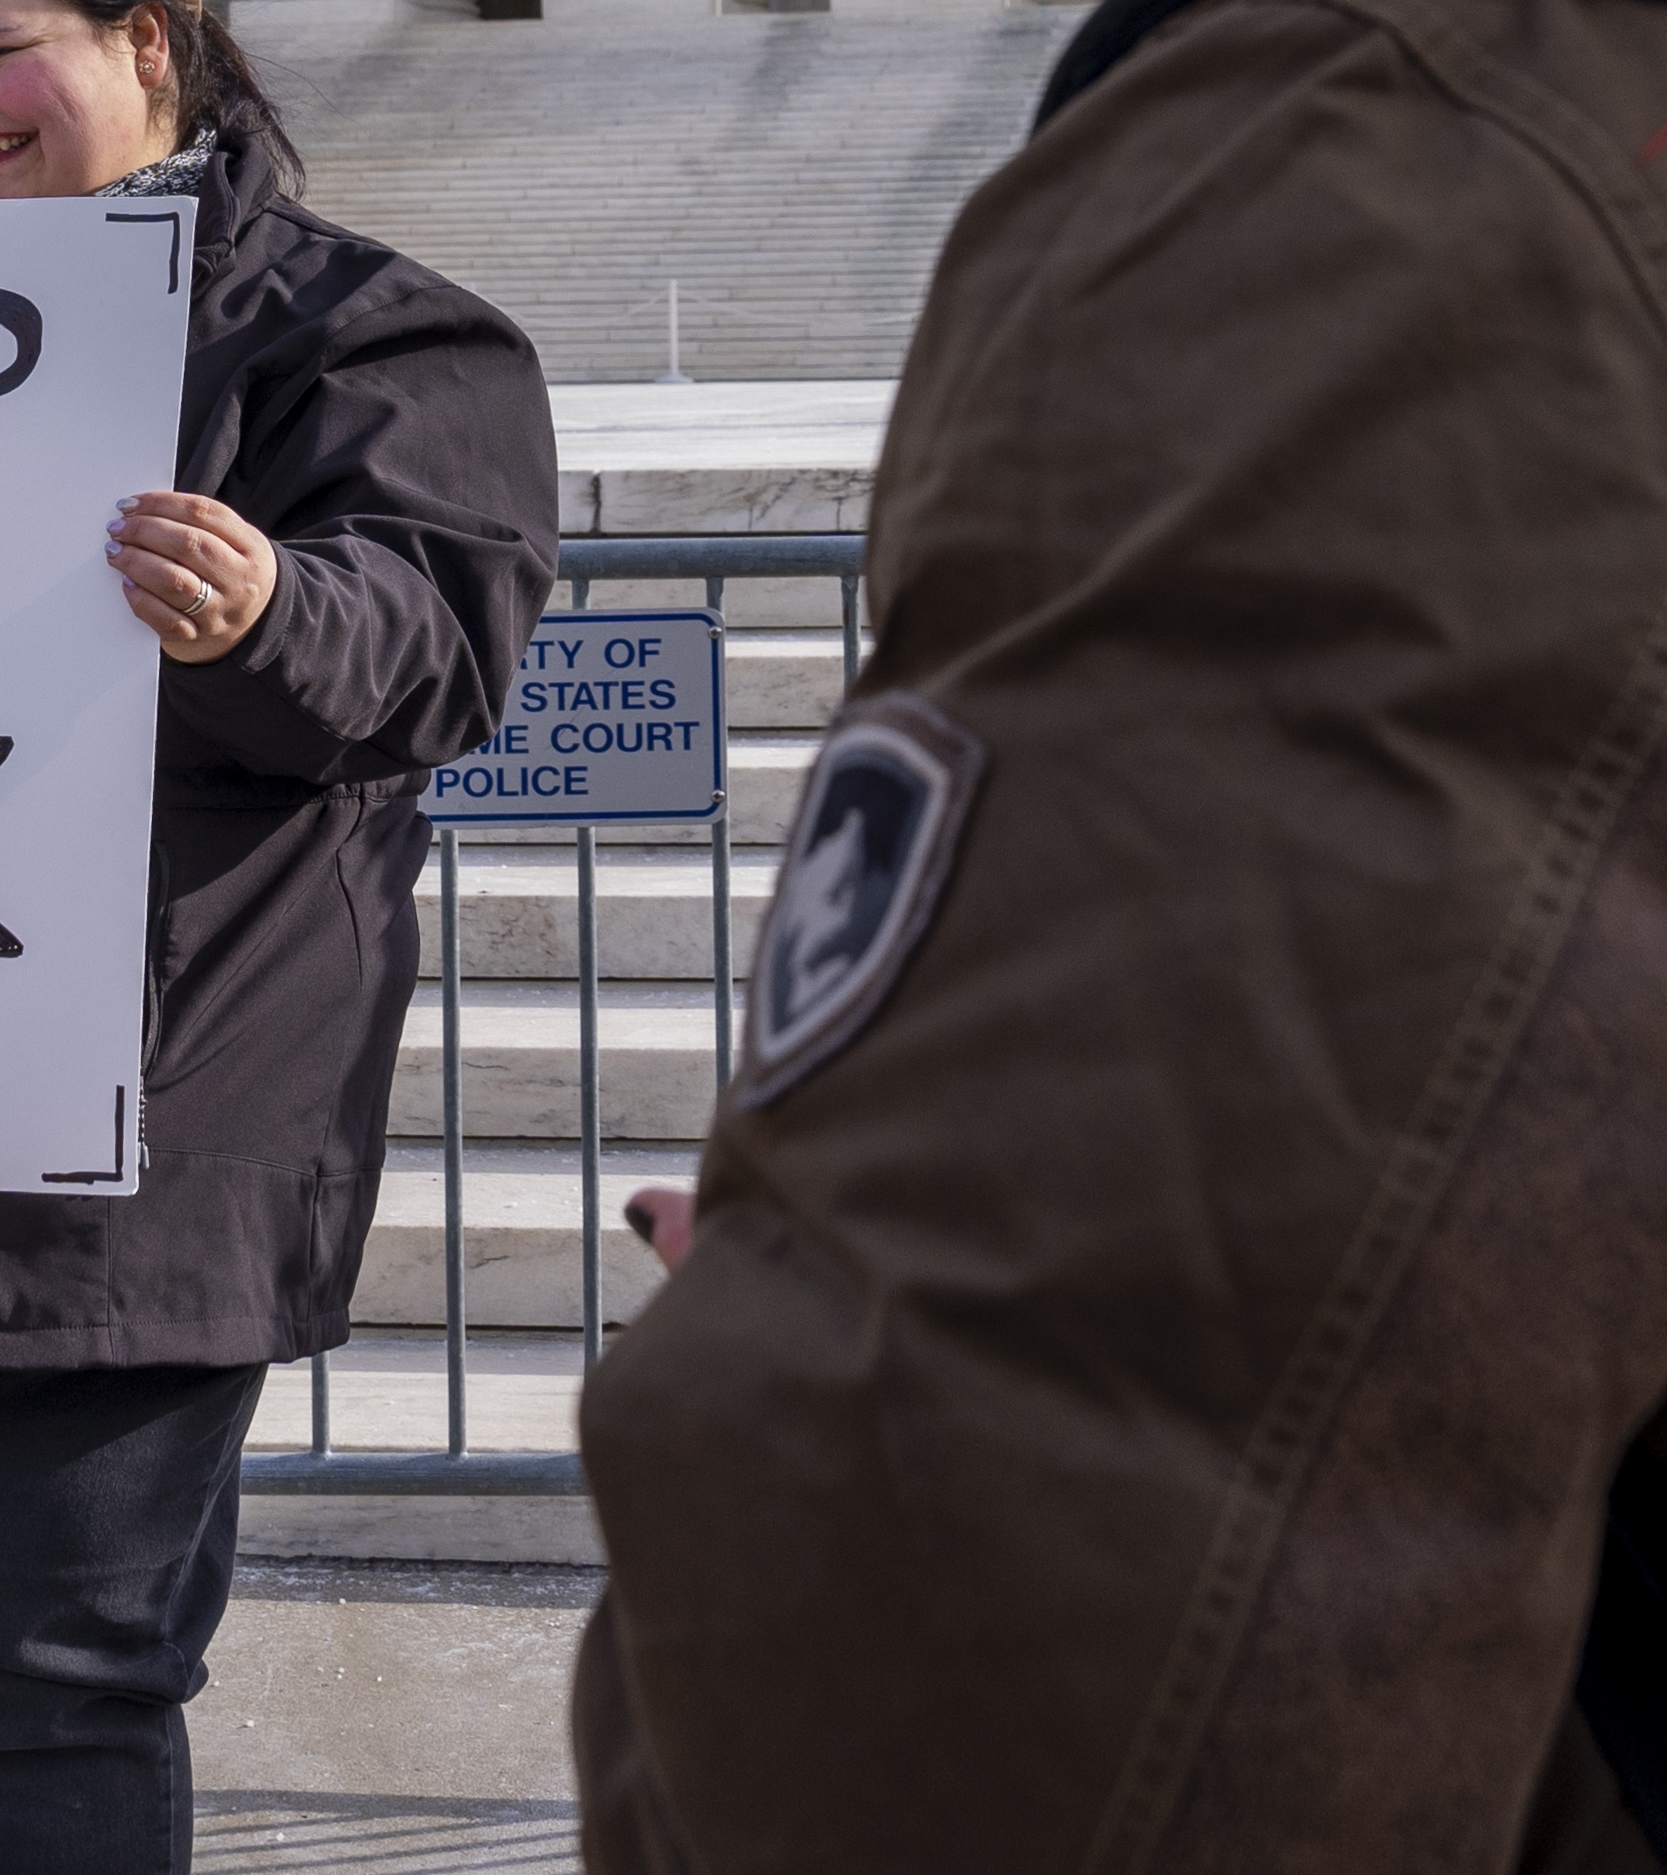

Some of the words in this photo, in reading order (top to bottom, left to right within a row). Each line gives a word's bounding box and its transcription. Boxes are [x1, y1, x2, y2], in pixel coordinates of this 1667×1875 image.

[604, 638, 662, 669] OF
[520, 679, 676, 713] STATES
[550, 721, 700, 754] COURT
[436, 766, 588, 798] POLICE
